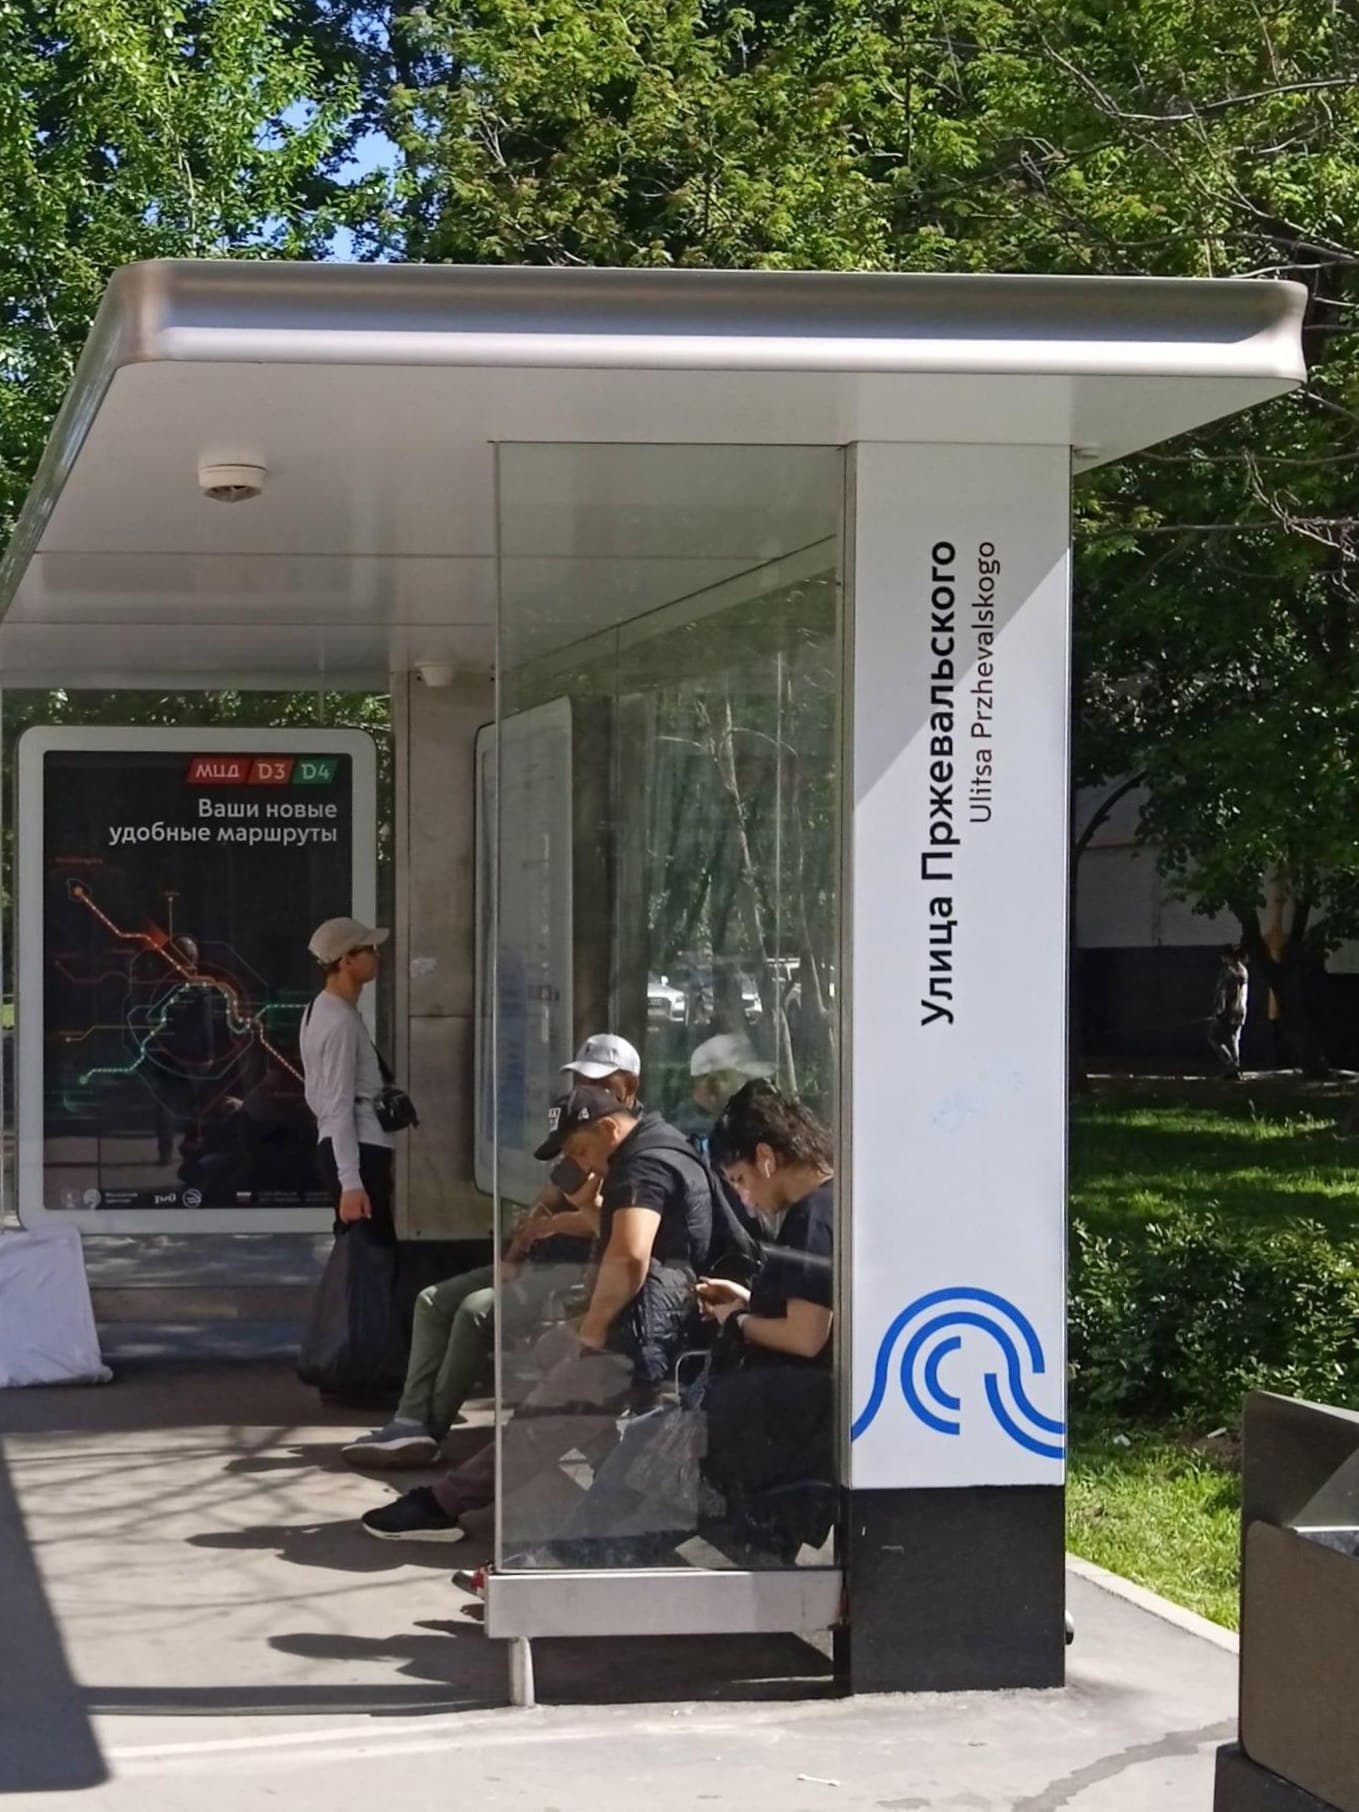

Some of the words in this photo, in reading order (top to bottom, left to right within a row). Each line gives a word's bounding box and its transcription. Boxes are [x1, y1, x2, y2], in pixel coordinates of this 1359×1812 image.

[969, 541, 1001, 739] Przhevalskogo
[920, 540, 961, 881] Пржевальского
[194, 763, 240, 779] МЦД
[257, 763, 286, 780] D3
[301, 764, 330, 780] D4
[198, 798, 259, 818] Ваши
[266, 803, 338, 819] новые
[969, 748, 994, 824] Ulitsa
[109, 821, 211, 846] удобные
[217, 826, 338, 847] маршруты
[920, 896, 958, 1027] Улица
